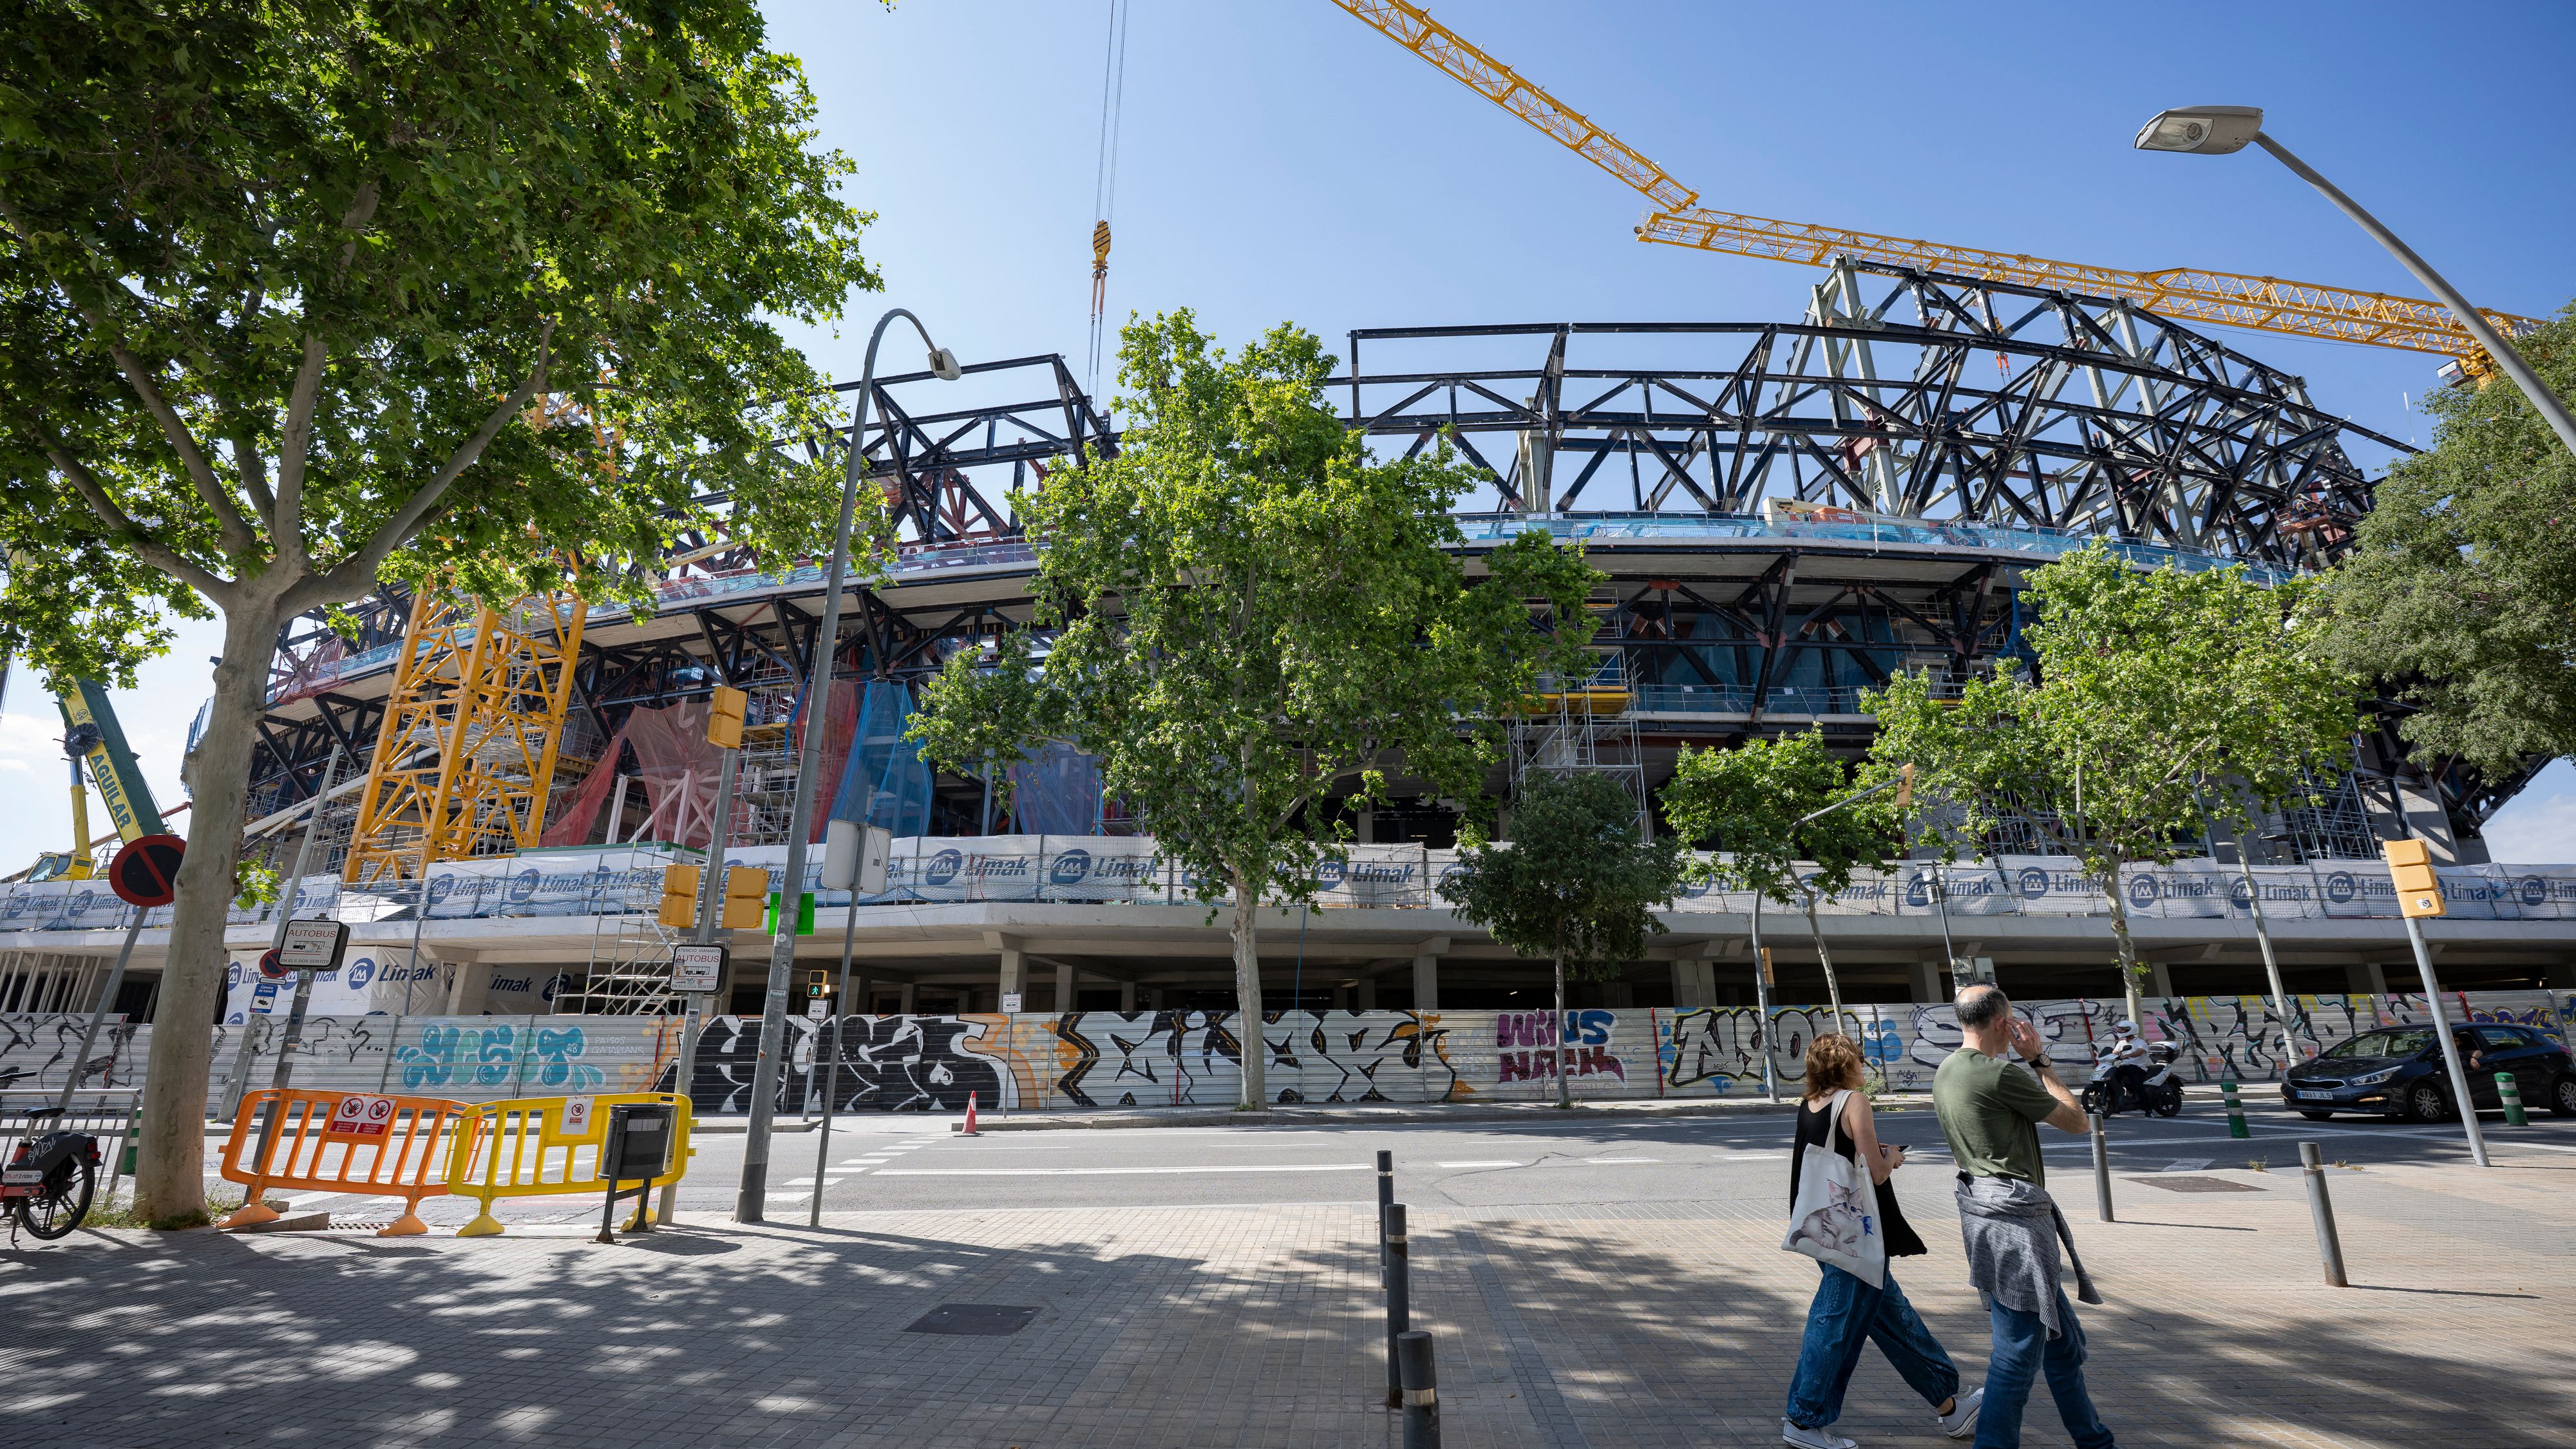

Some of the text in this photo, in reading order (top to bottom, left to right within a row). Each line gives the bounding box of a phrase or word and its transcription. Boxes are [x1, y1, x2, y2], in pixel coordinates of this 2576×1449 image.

[91, 754, 131, 829] AGUILAR
[1094, 858, 1158, 877] Limak
[1352, 864, 1416, 883] Limak
[453, 878, 500, 896] Limak
[2164, 878, 2213, 897] Limak
[2265, 884, 2311, 902] Limak
[287, 929, 336, 938] AUTOBUS
[489, 974, 533, 992] imak
